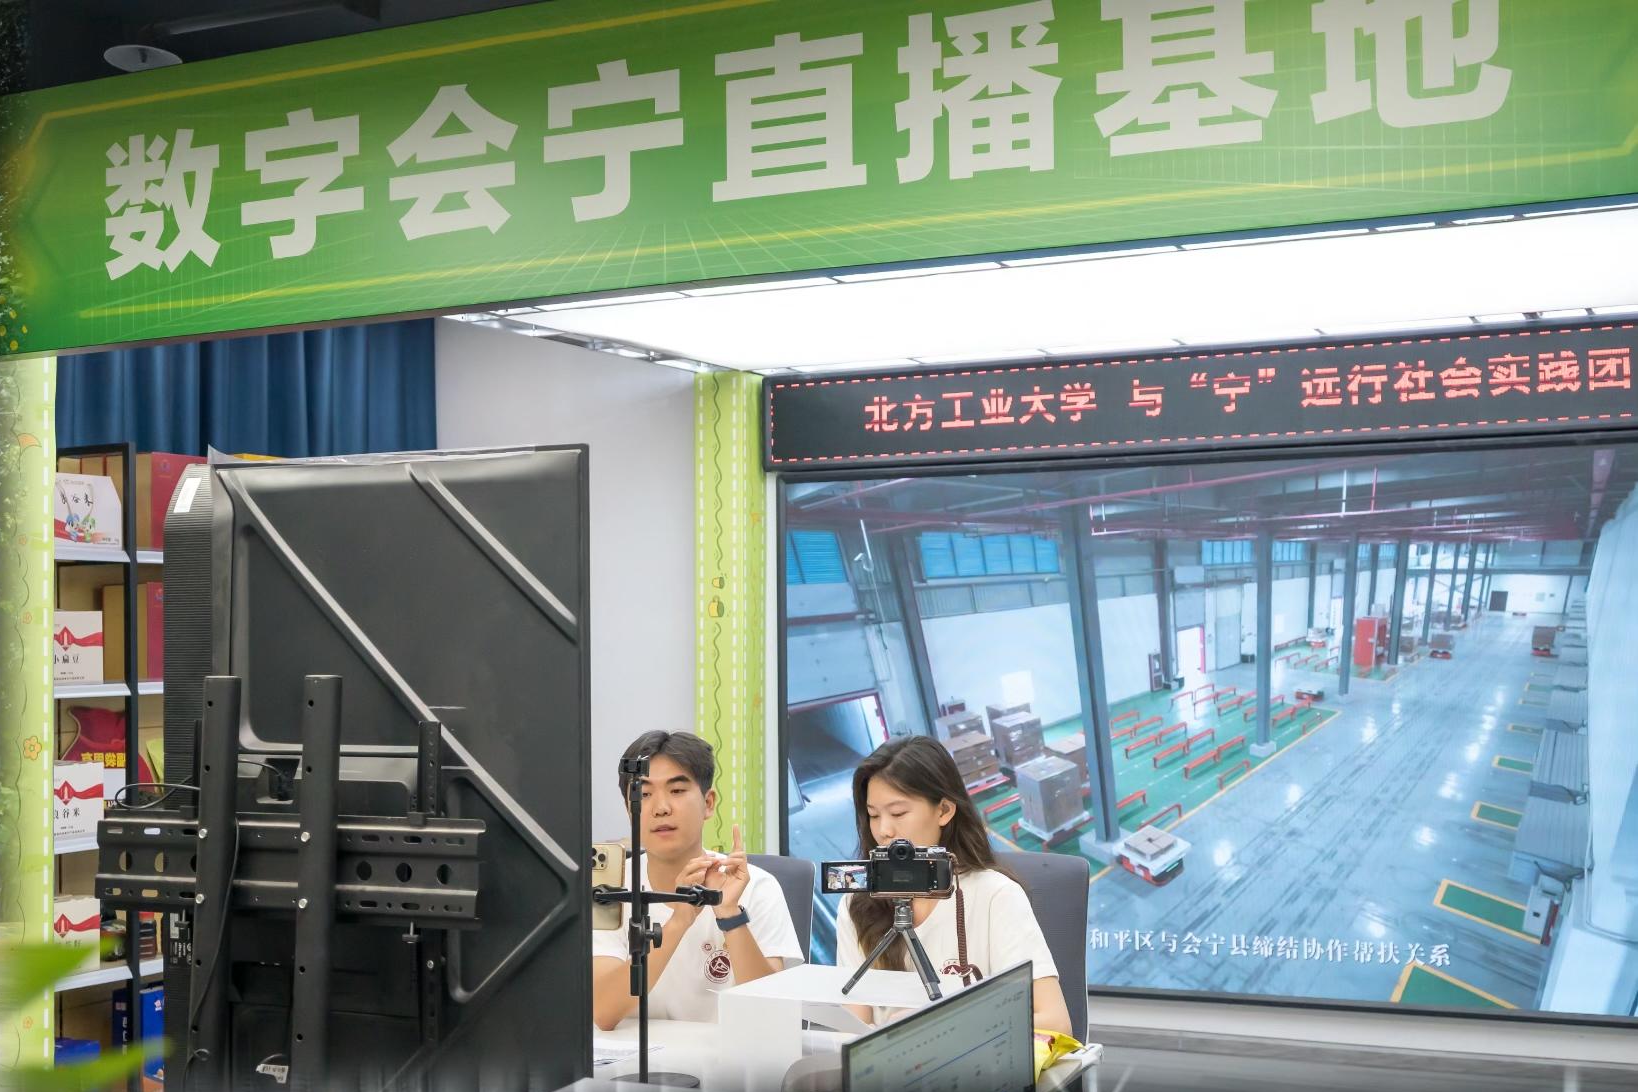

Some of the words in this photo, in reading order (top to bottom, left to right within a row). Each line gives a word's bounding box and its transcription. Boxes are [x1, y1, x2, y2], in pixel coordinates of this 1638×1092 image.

[105, 0, 1513, 281] 数字会宁直播基地
[865, 383, 1097, 432] 北方工业大学
[1089, 928, 1451, 968] 和平区与会宁县缔结协作帮扶关系
